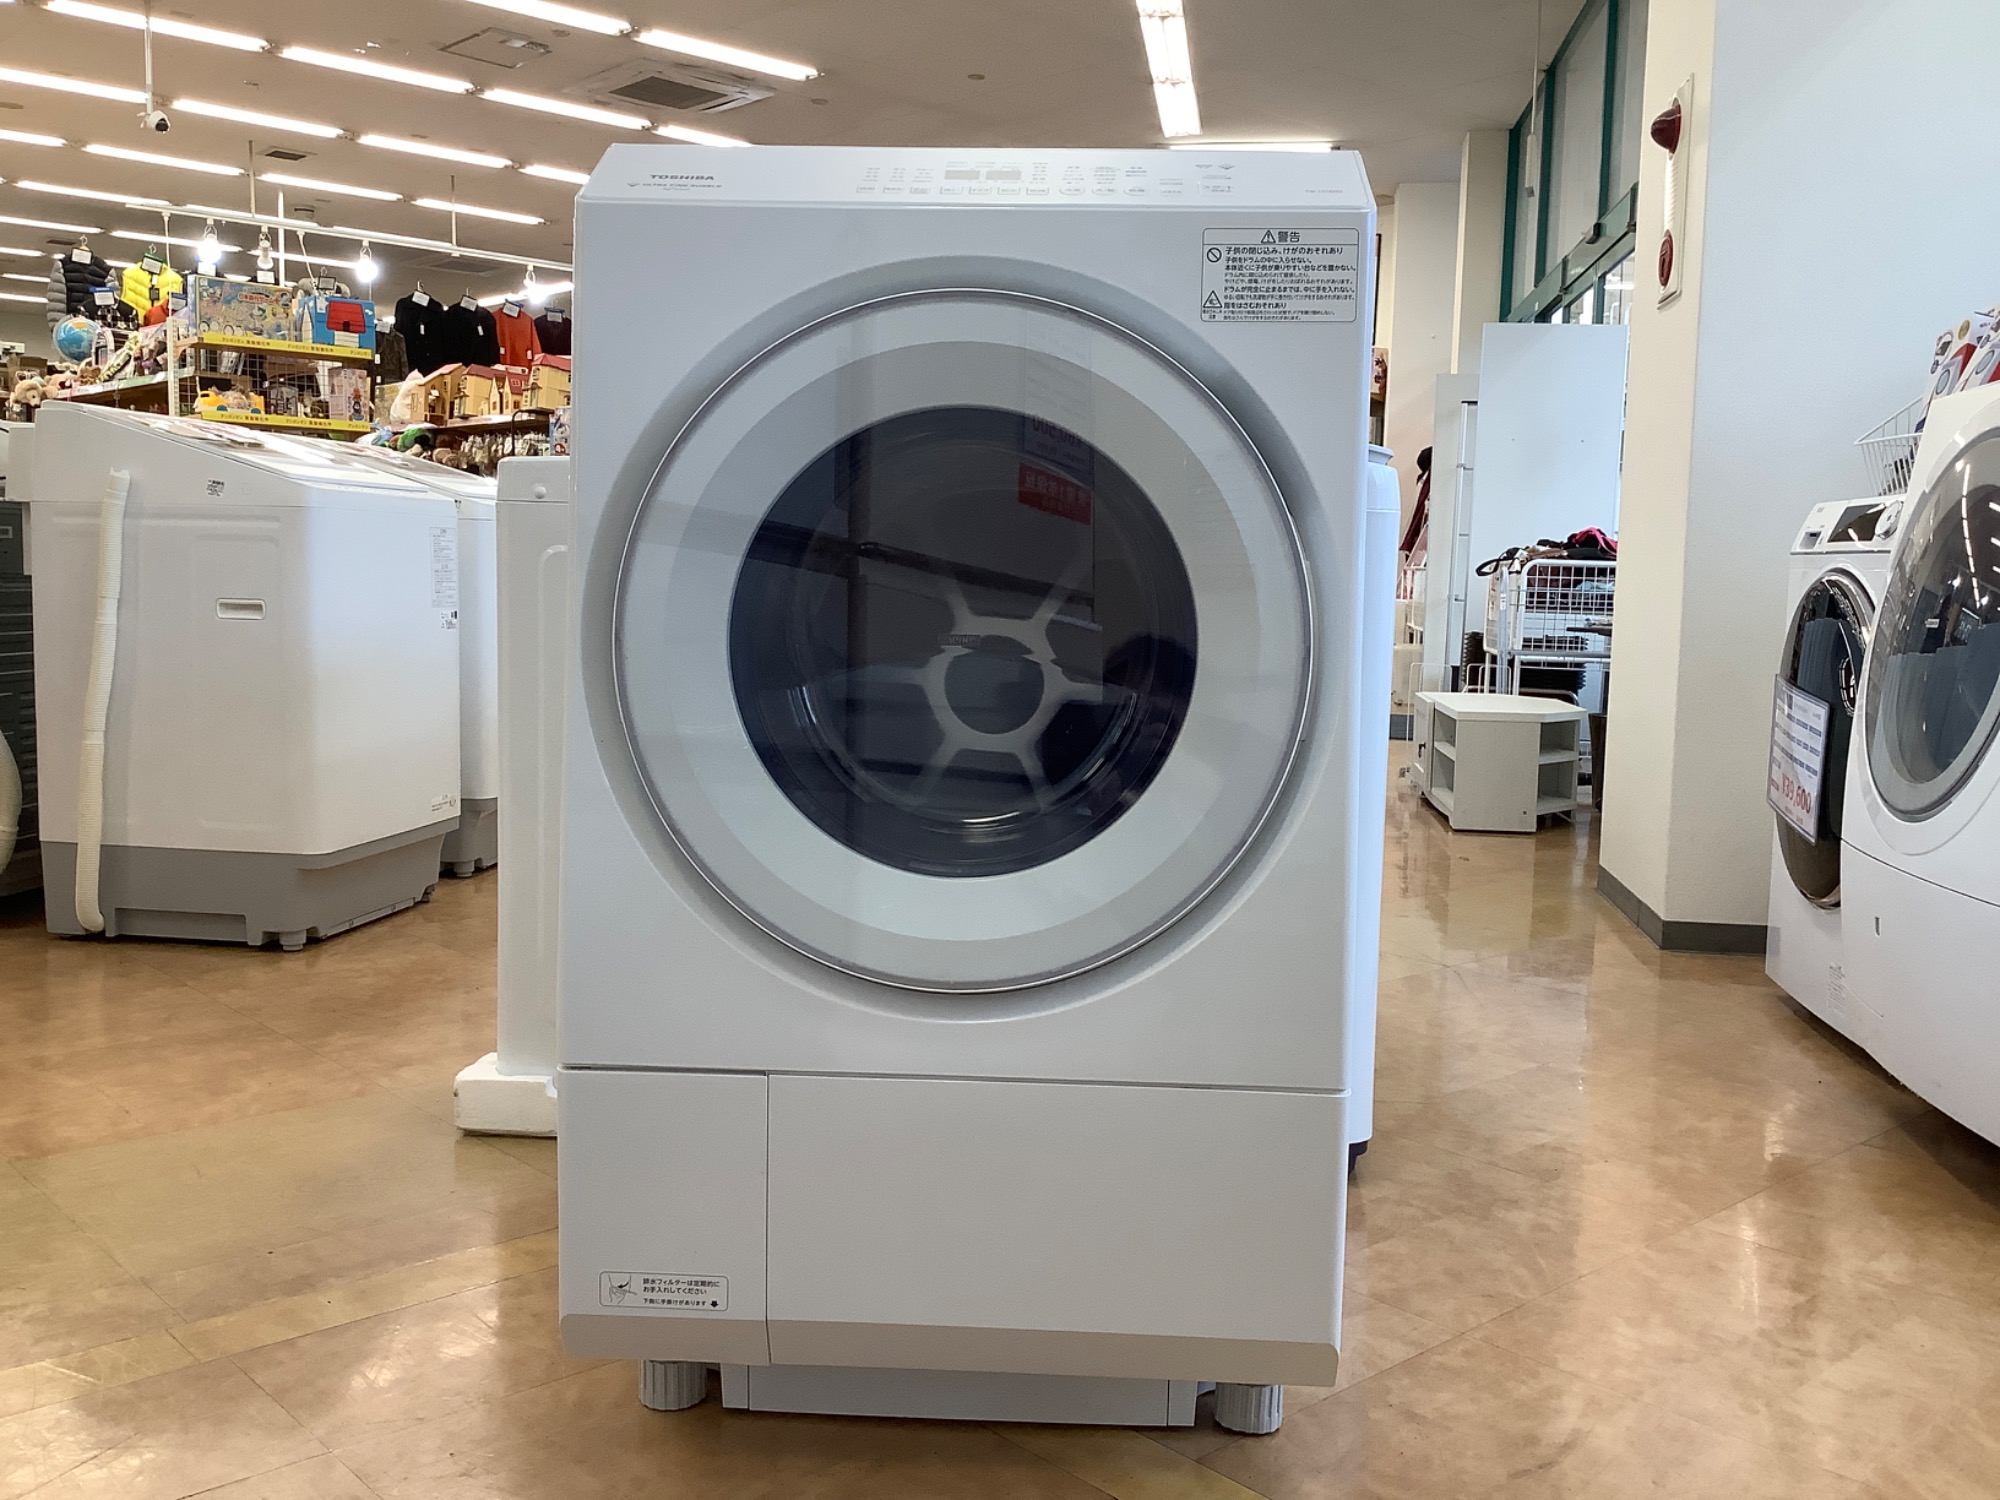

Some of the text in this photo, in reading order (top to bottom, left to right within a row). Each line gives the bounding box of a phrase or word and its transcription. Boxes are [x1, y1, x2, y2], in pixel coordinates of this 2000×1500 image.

[1277, 231, 1300, 243] 警告
[643, 1286, 707, 1295] お手入れしてください
